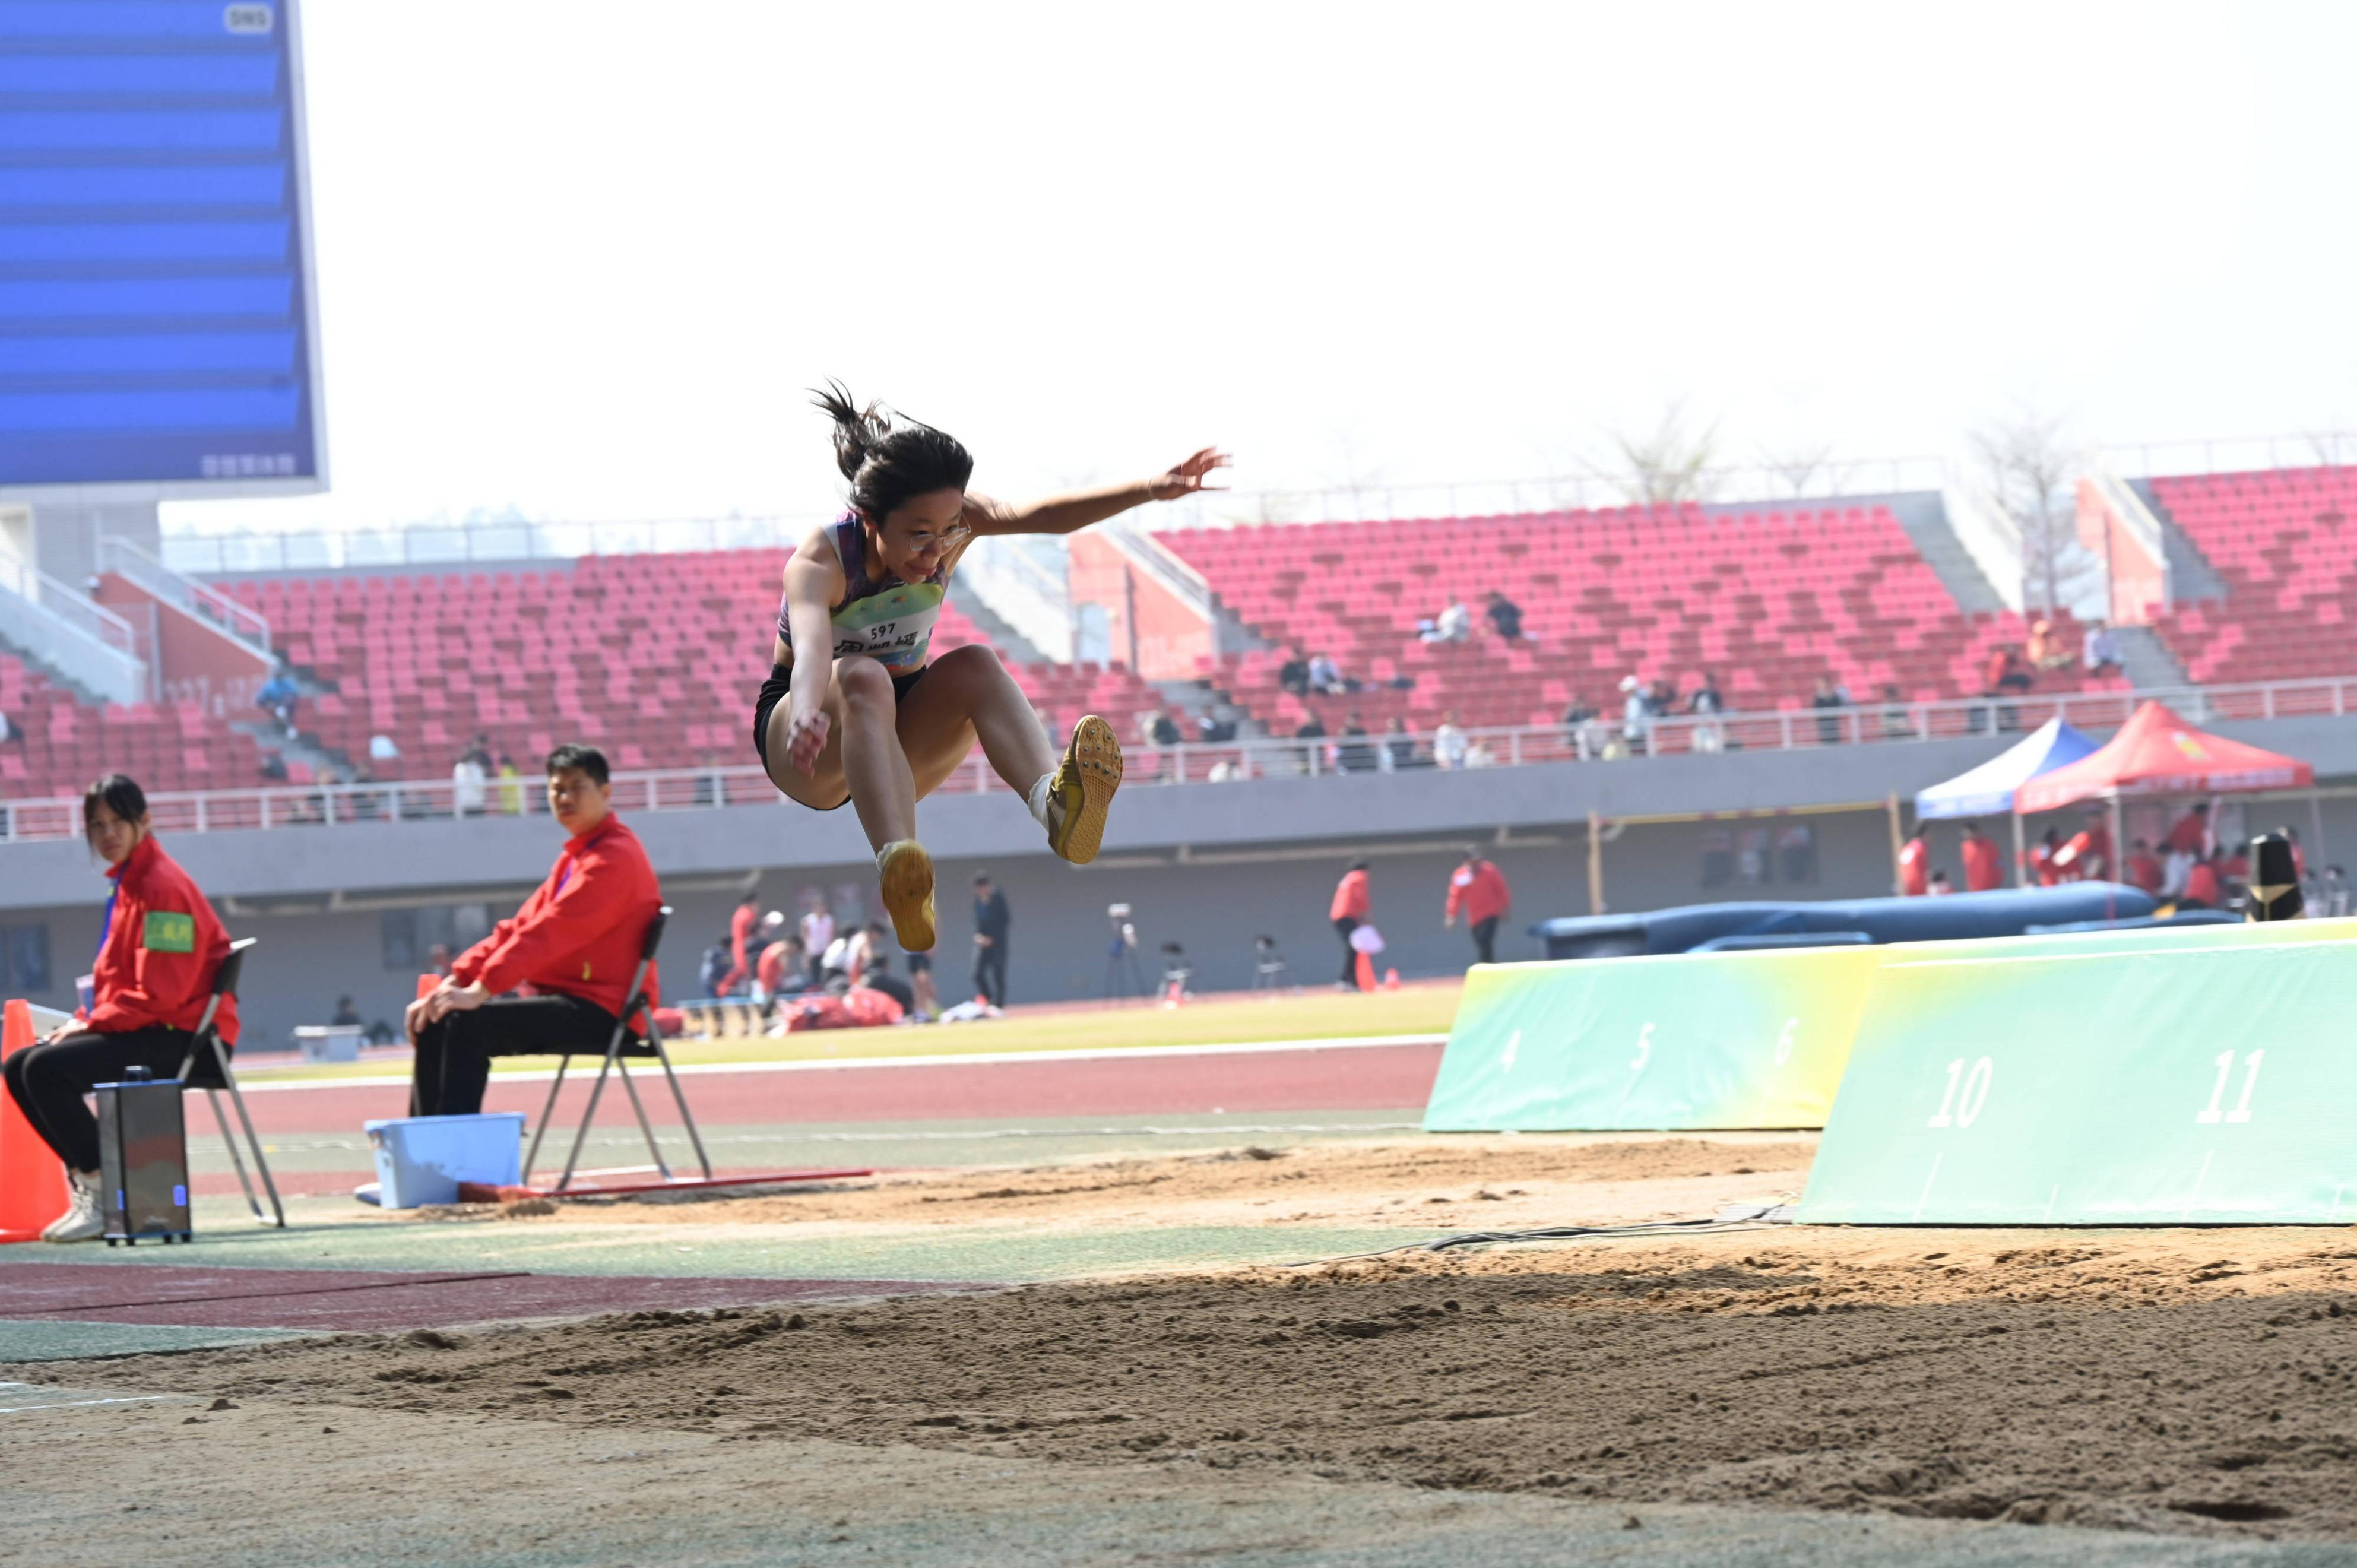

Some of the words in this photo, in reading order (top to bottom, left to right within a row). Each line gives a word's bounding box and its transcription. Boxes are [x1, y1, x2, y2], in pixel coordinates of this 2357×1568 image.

[870, 623, 896, 641] 597
[1500, 1028, 1522, 1074] 4
[1629, 1022, 1656, 1071] 5
[1773, 1017, 1799, 1068] 6
[1927, 1056, 1994, 1129] 10
[2194, 1048, 2266, 1124] 11
